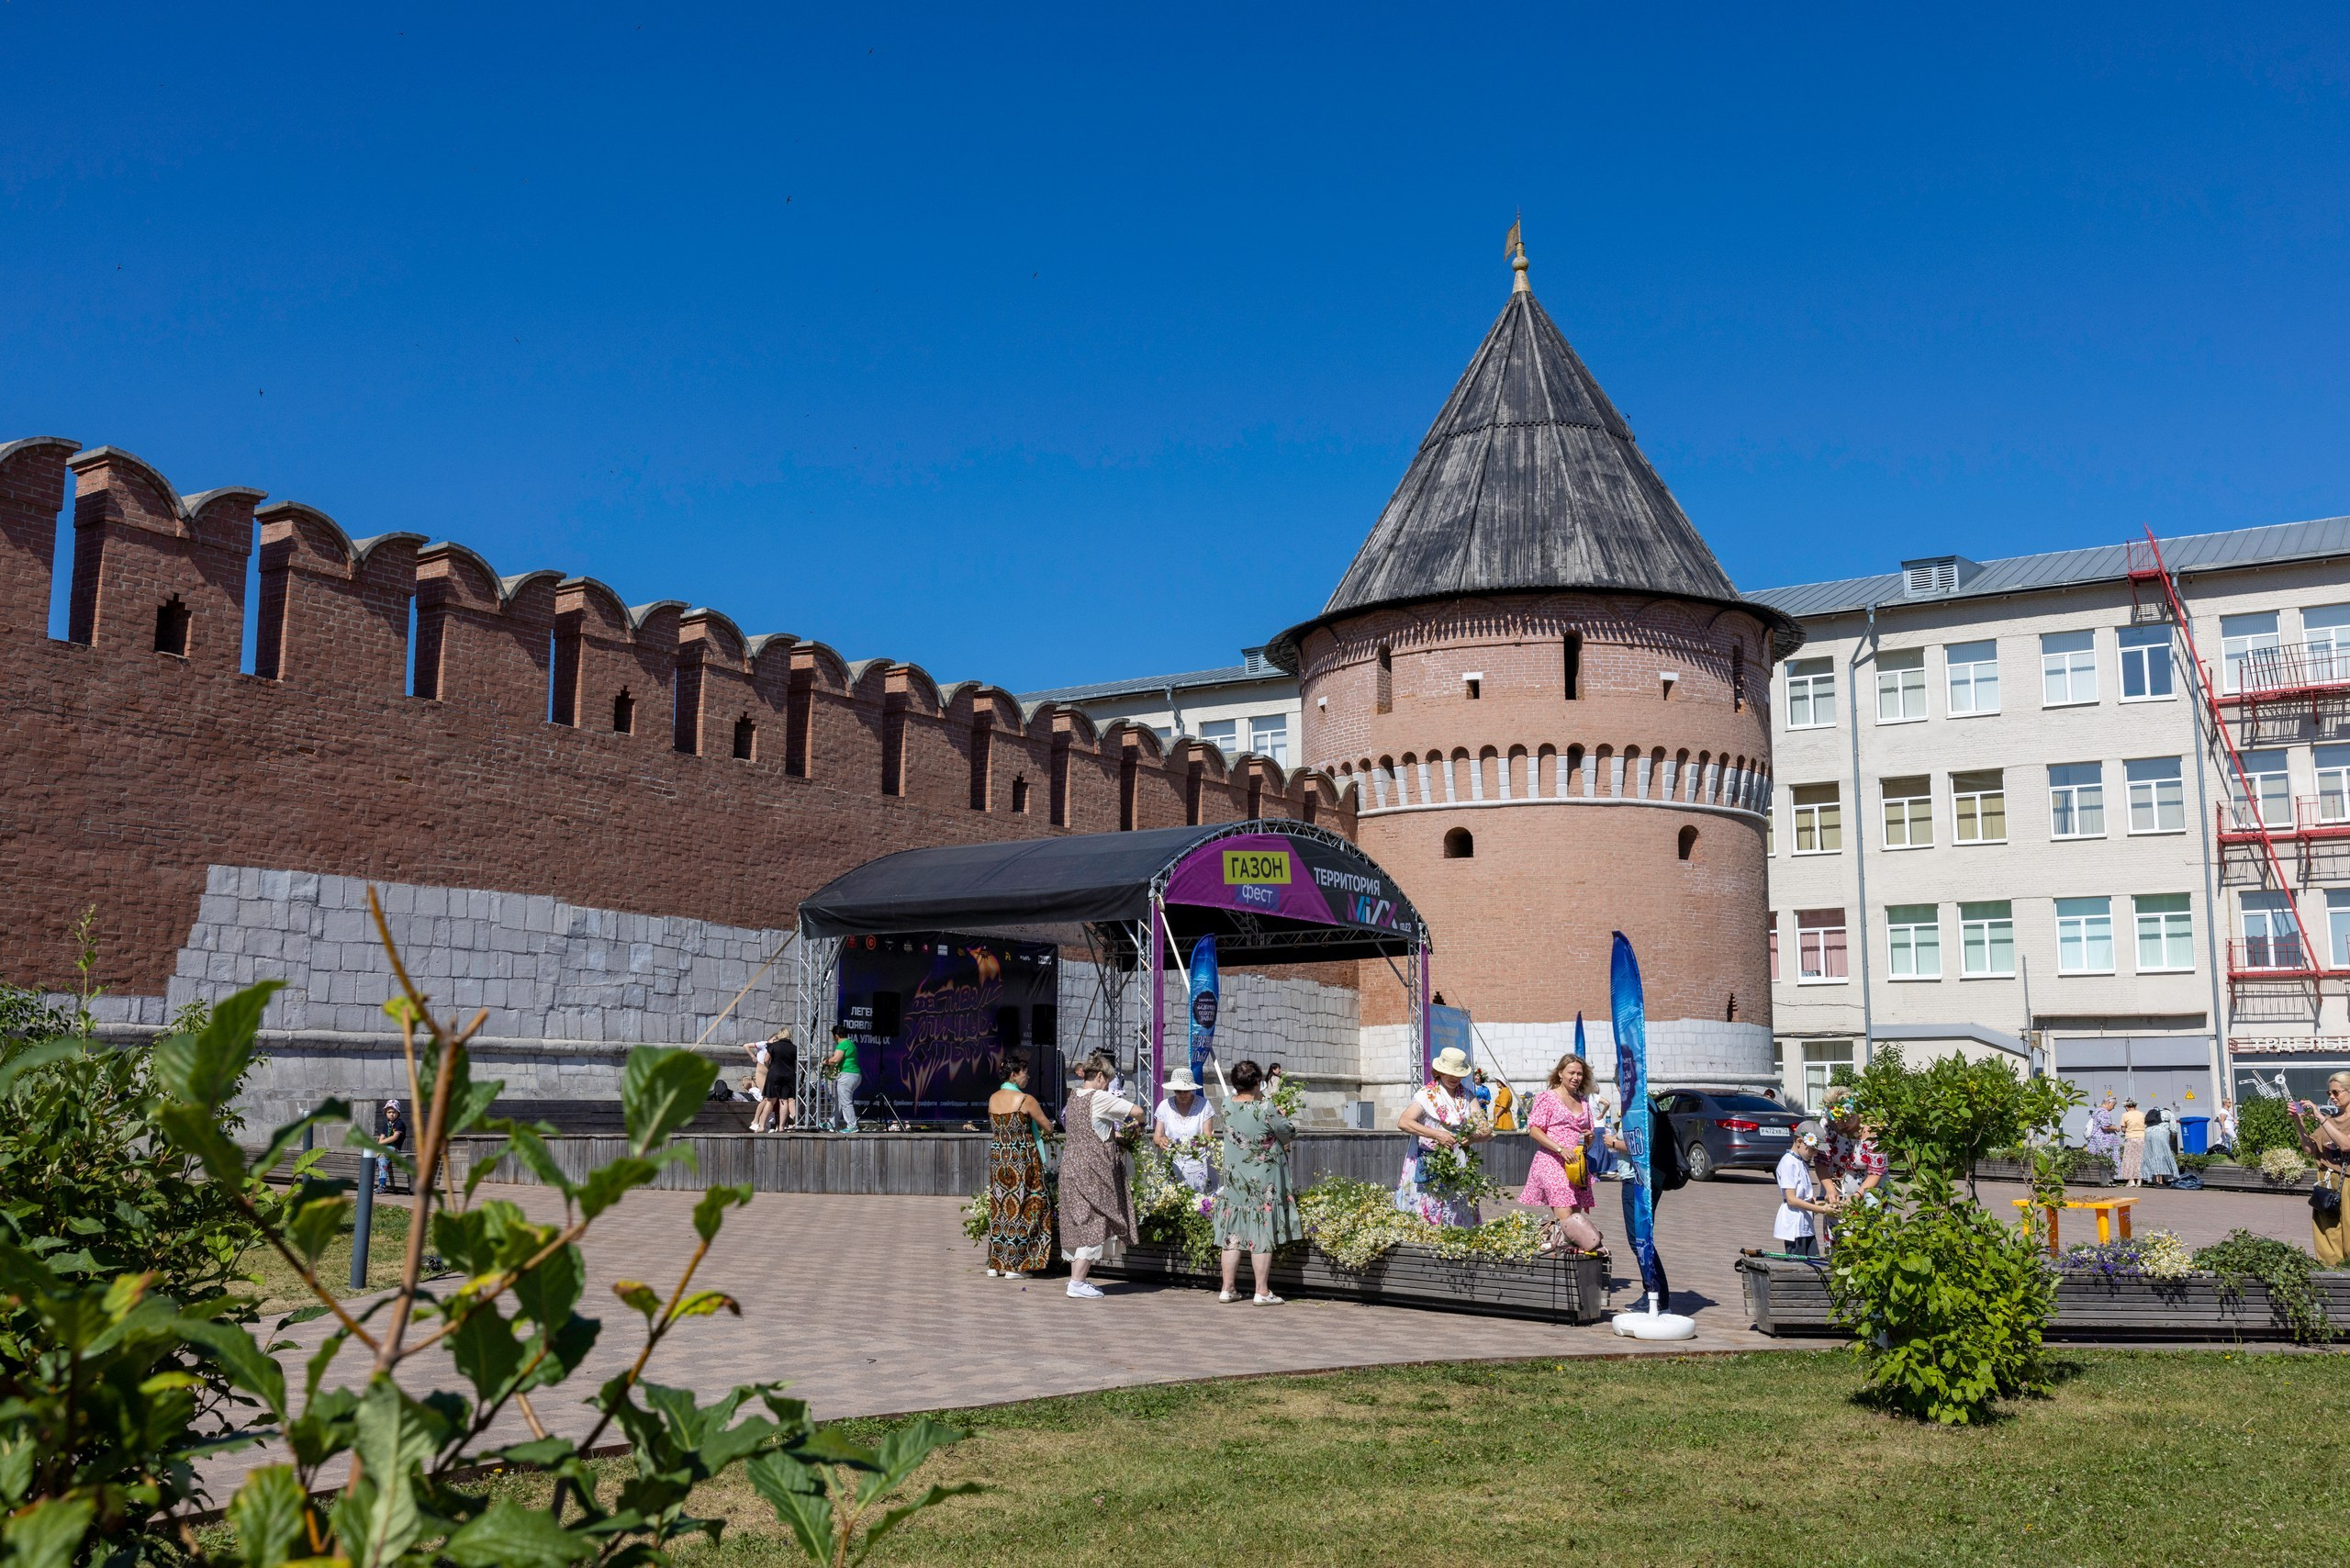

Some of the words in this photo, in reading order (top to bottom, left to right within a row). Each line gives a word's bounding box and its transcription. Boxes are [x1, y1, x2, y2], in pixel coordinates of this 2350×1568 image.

[1231, 857, 1283, 879] ГАЗОН
[1314, 866, 1381, 896] ТЕРРИТОРИЯ
[1242, 884, 1273, 903] фест
[1399, 923, 1412, 933] TELE2
